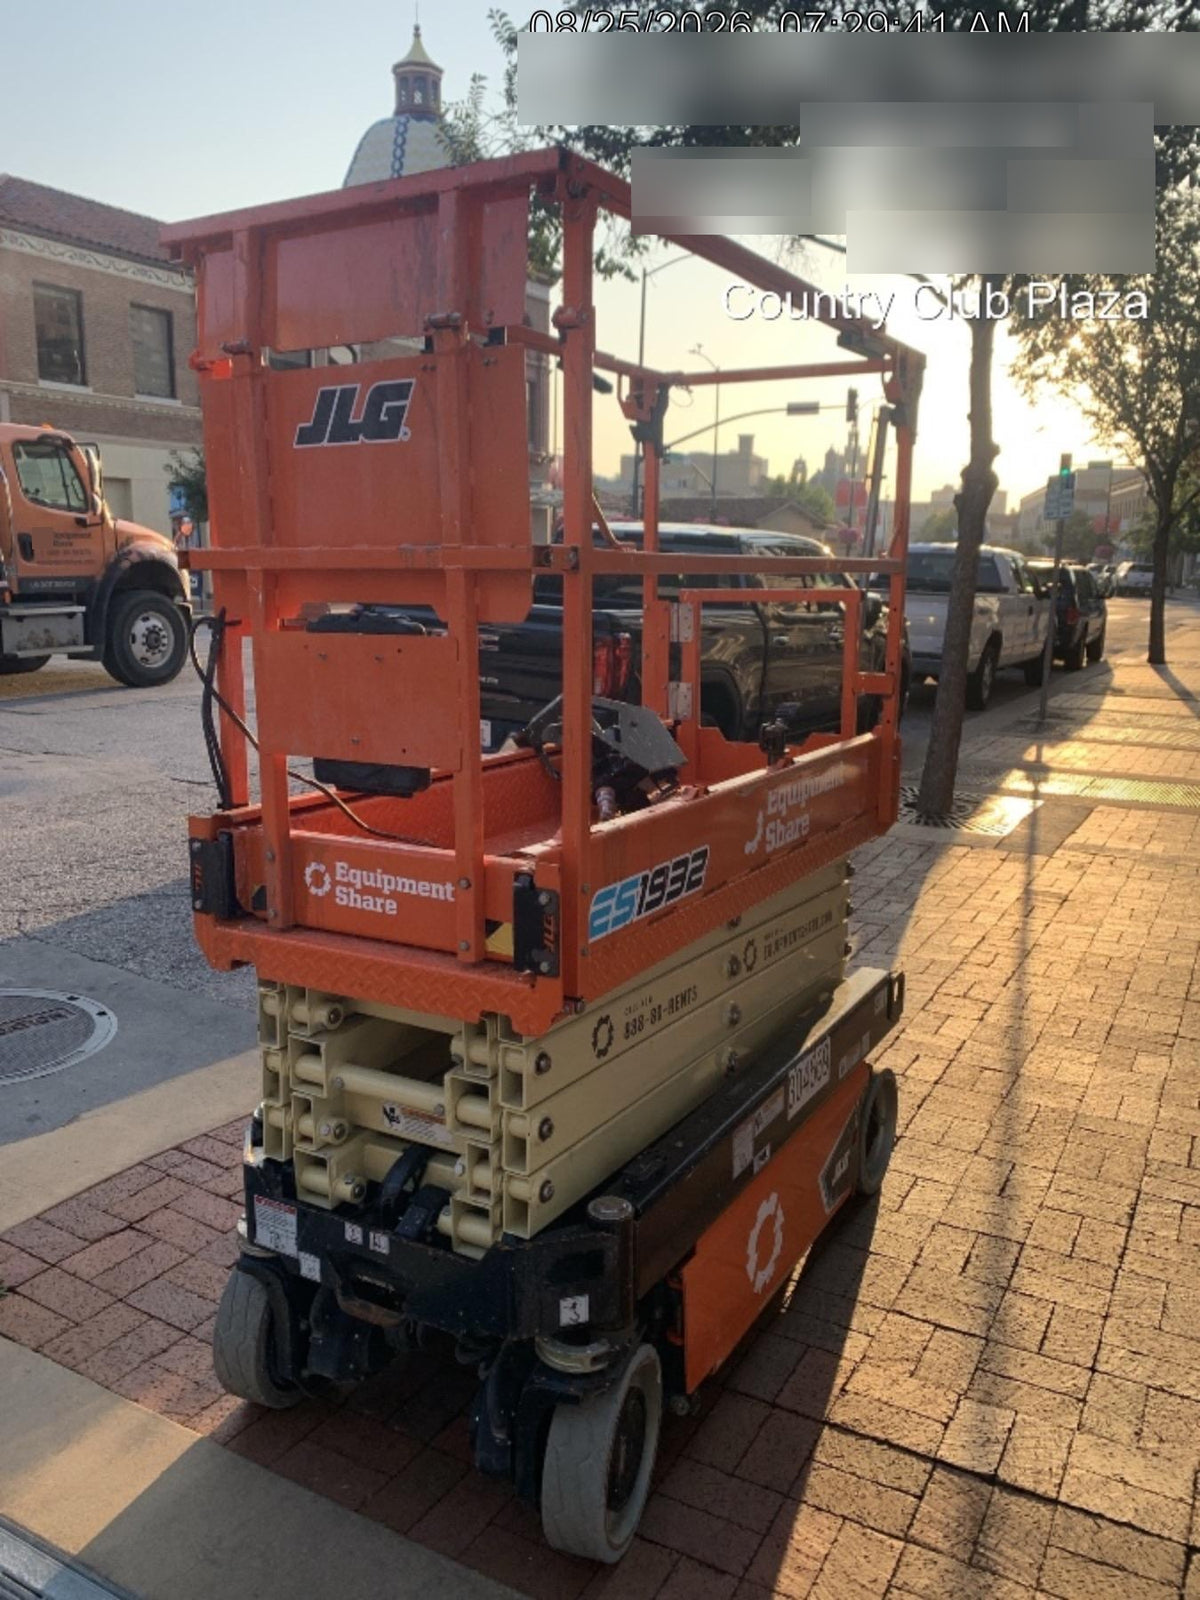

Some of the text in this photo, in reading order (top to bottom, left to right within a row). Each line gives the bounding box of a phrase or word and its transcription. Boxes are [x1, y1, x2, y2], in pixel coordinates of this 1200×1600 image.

[293, 378, 415, 448] JLG
[765, 812, 810, 852] Share
[335, 861, 455, 902] Equipment
[335, 886, 397, 915] Share
[589, 845, 709, 943] ES1932
